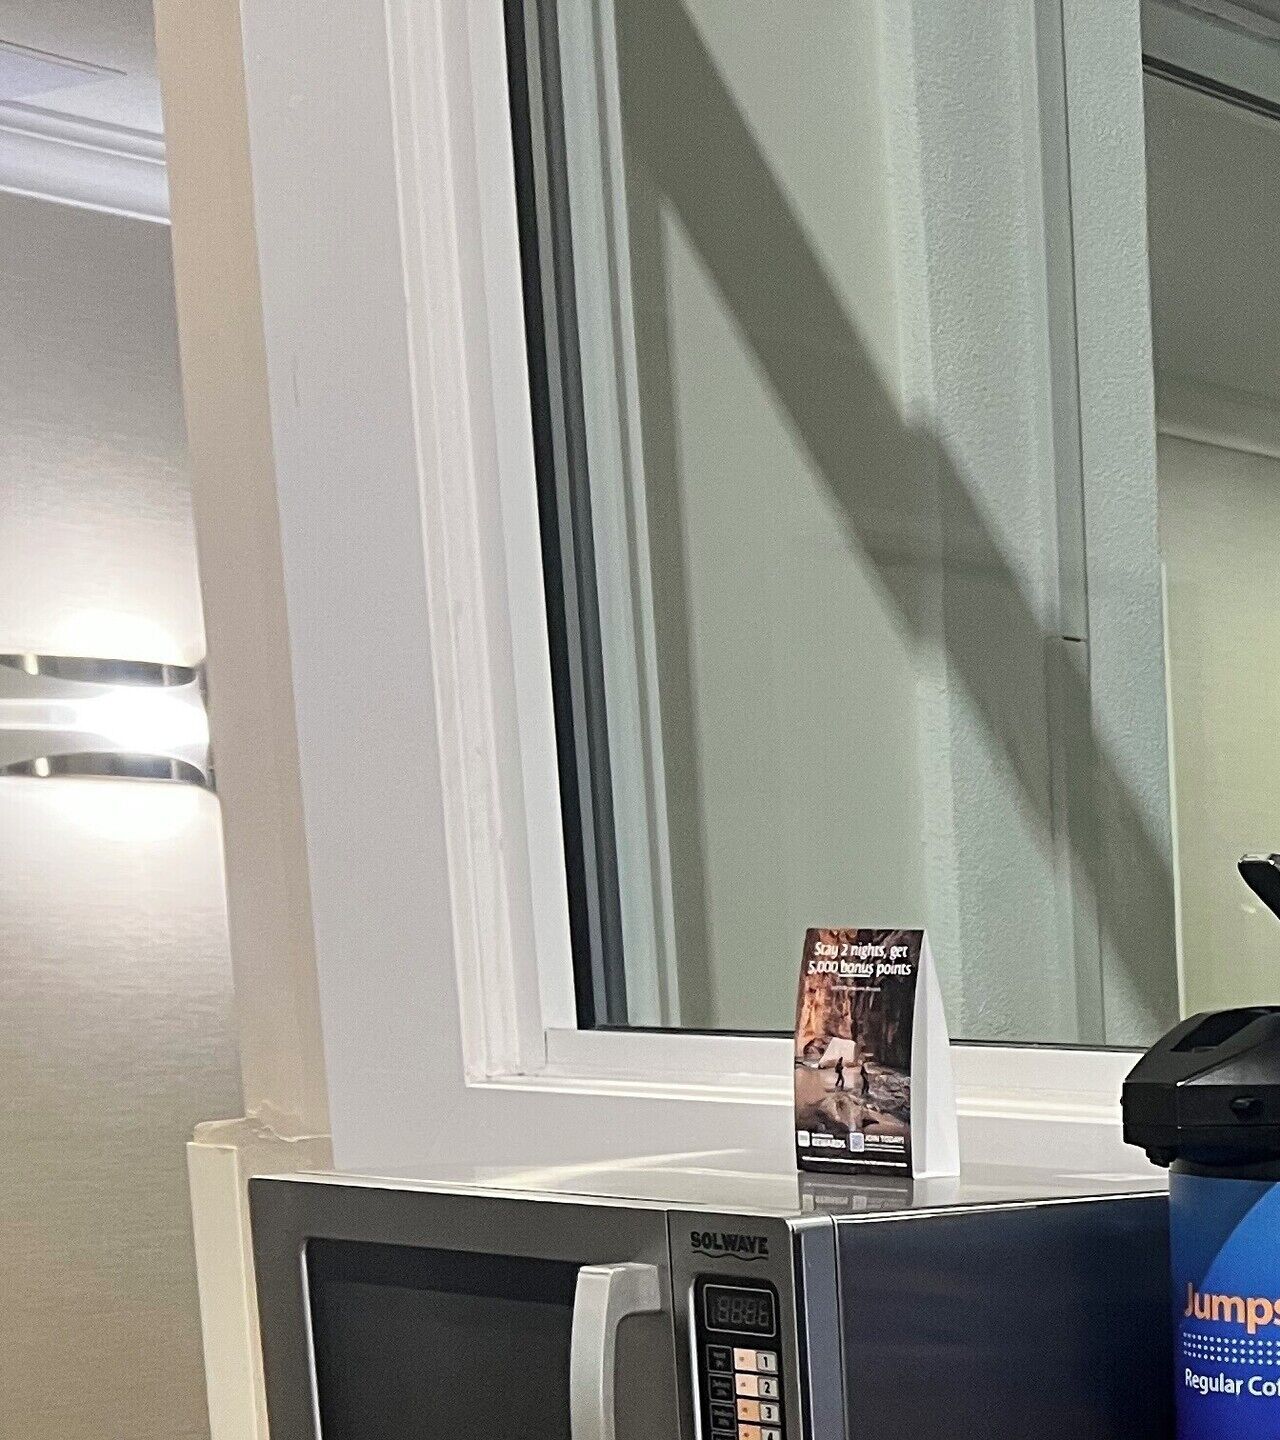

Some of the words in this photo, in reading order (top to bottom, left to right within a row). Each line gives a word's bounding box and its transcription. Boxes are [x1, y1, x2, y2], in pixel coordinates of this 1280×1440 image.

[814, 942, 839, 960] Stay
[841, 943, 849, 957] 2
[889, 945, 909, 961] get
[840, 959, 874, 974] bonus
[876, 963, 912, 977] points
[690, 1231, 769, 1255] SOLWAVE
[1184, 1368, 1244, 1395] Regular
